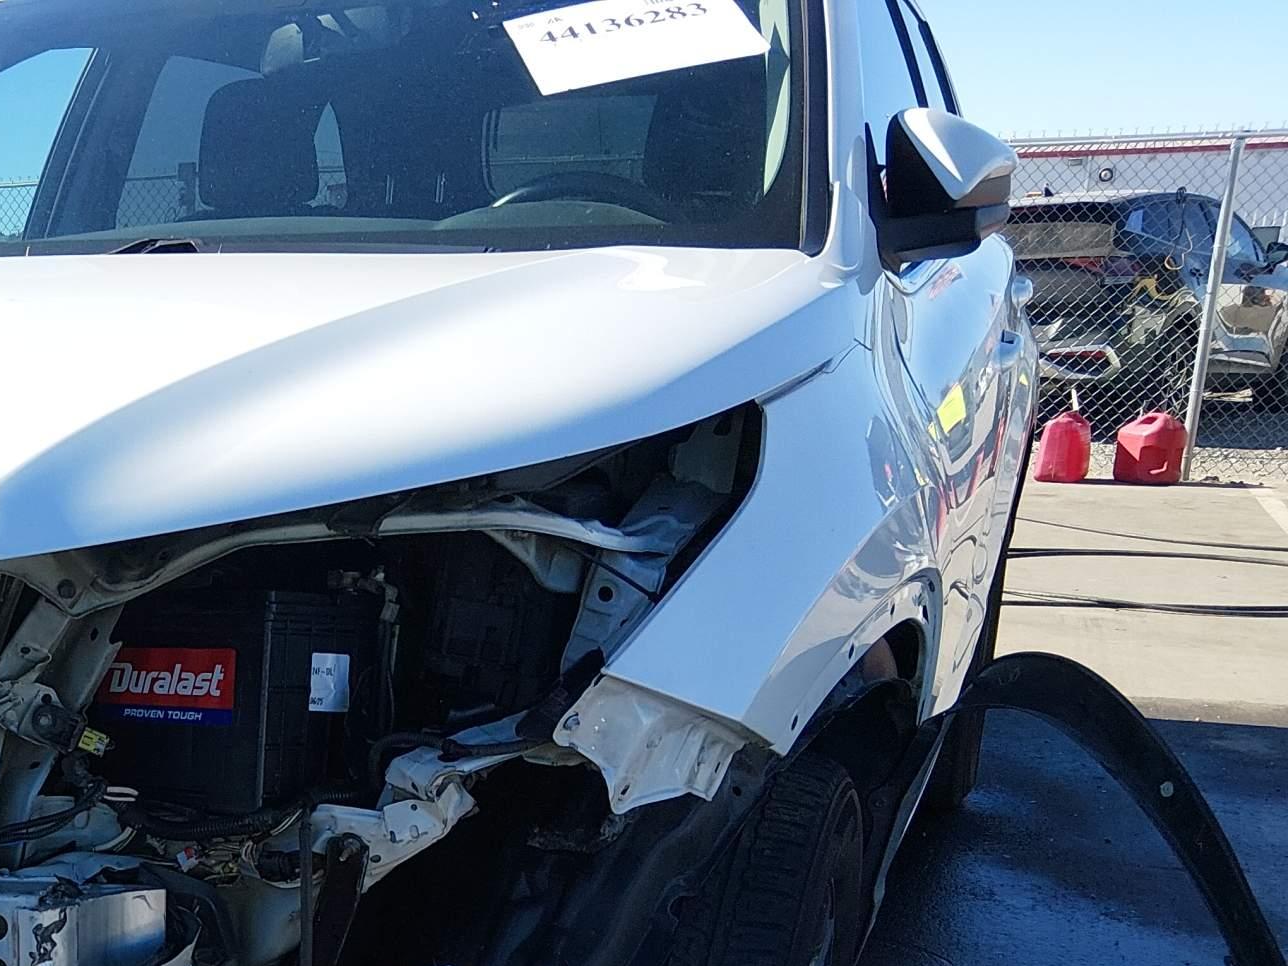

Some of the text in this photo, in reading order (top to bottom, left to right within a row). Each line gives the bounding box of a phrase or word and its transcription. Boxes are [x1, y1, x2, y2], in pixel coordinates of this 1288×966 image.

[539, 2, 709, 44] 44136283
[109, 662, 225, 697] Duralast
[123, 708, 203, 721] PROVEN TOUGH
